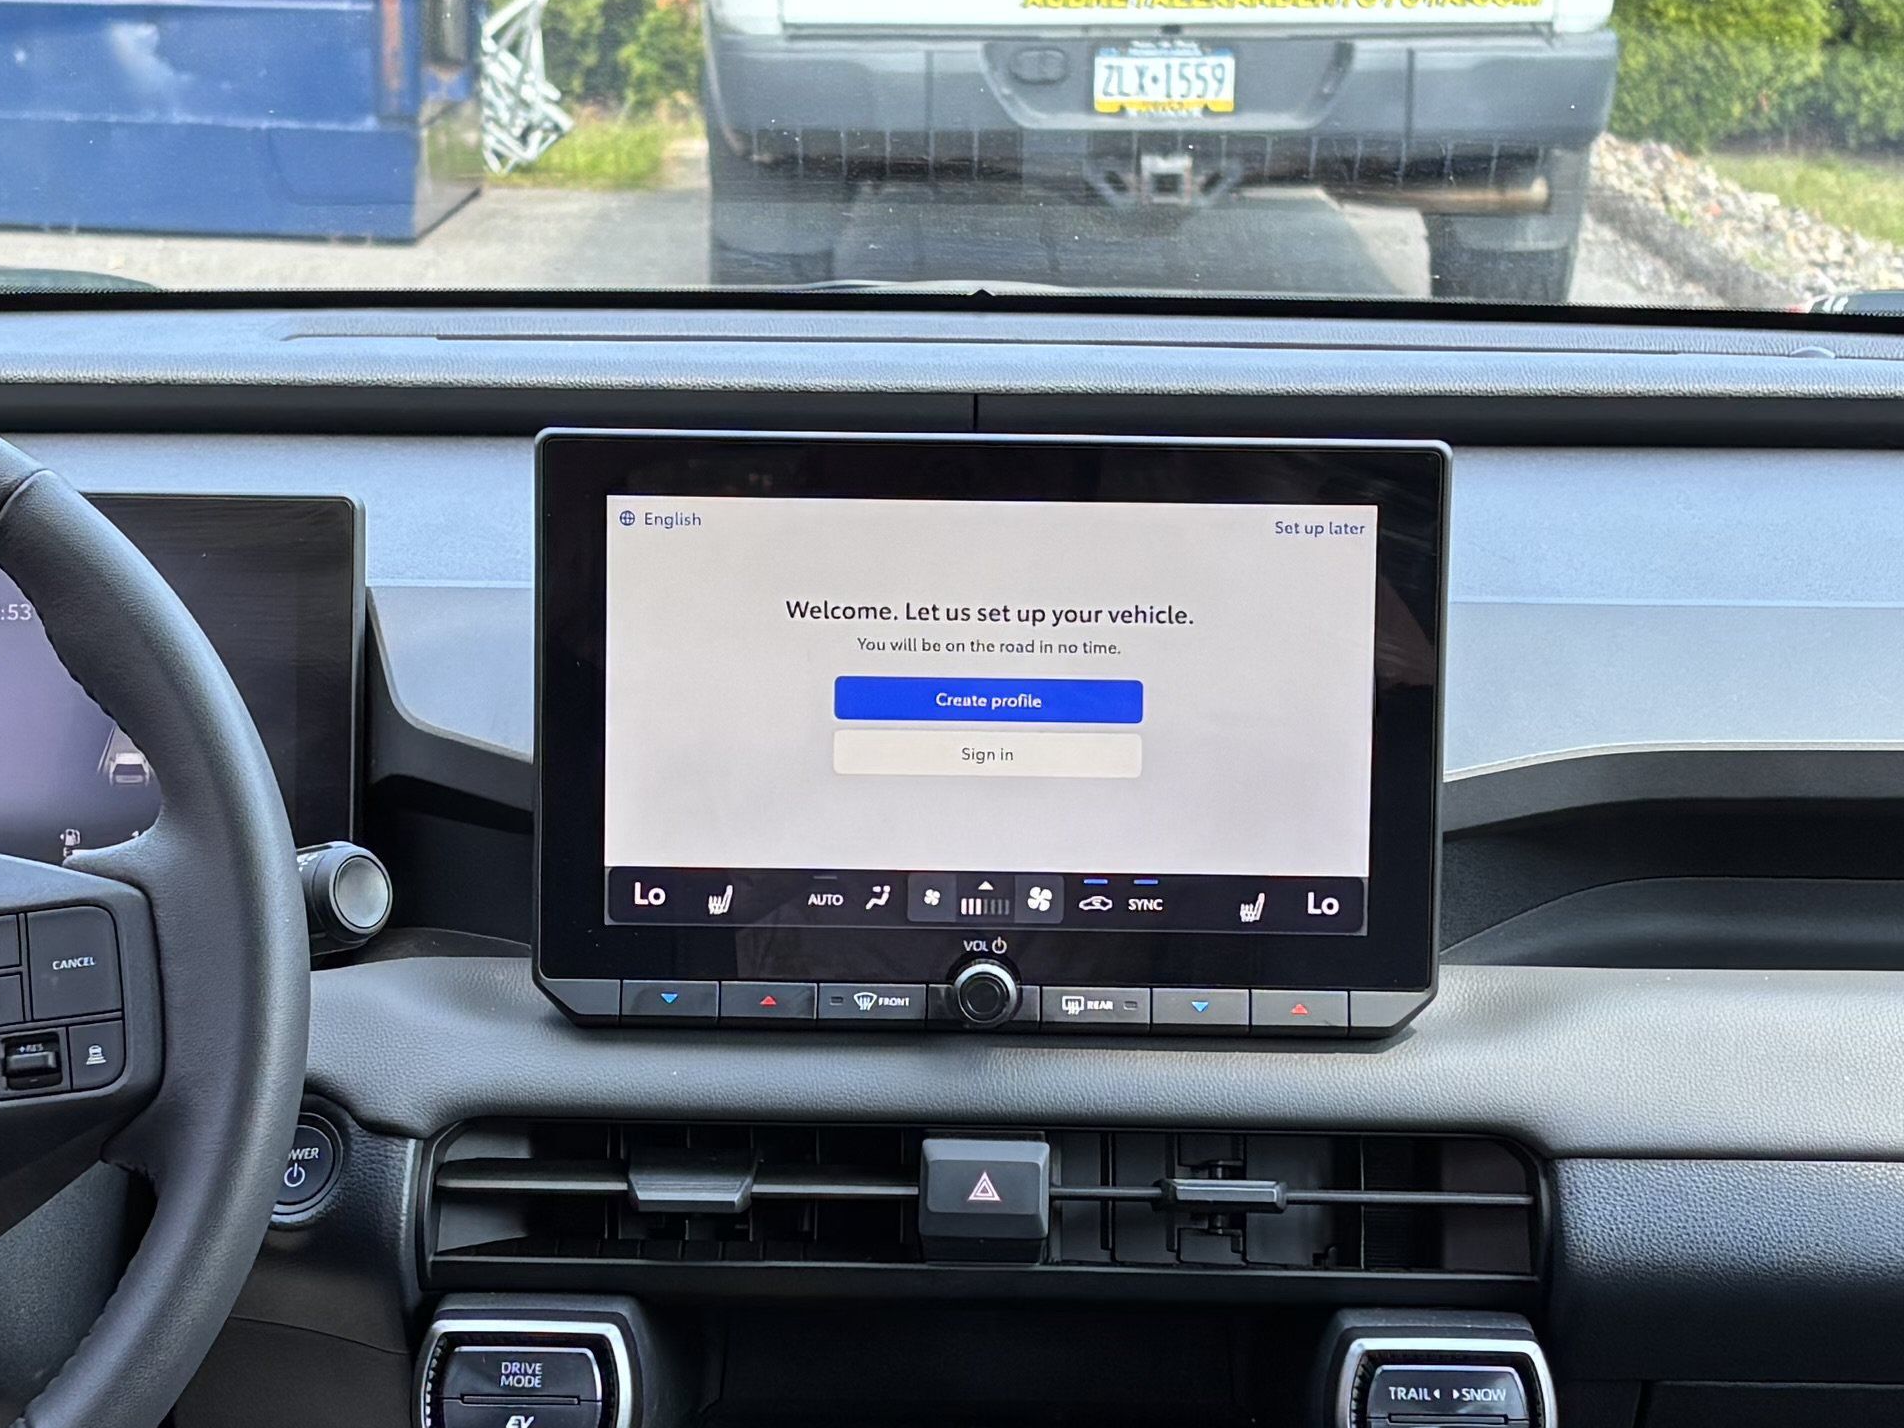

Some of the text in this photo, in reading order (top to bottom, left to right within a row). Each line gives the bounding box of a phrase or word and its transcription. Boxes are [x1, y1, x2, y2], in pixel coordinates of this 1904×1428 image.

[642, 510, 703, 530] English
[1274, 519, 1367, 540] Set up later
[786, 600, 1195, 628] Welcome. Let us set up your vehicle.
[857, 637, 1122, 655] You will be on the road in no time.
[935, 692, 1042, 711] Create profile
[961, 746, 1014, 765] Sign in
[633, 881, 666, 906] Lo
[807, 893, 845, 907] AUTO
[1127, 898, 1164, 912] SYNC
[1306, 892, 1340, 916] Lo
[963, 939, 989, 953] VOL
[51, 954, 96, 971] CANCEL
[878, 996, 910, 1007] FRONT
[1087, 1000, 1114, 1011] REAR
[500, 1361, 544, 1376] DRIVE
[500, 1375, 543, 1389] MODE
[1388, 1385, 1507, 1403] TRAIL SNOW
